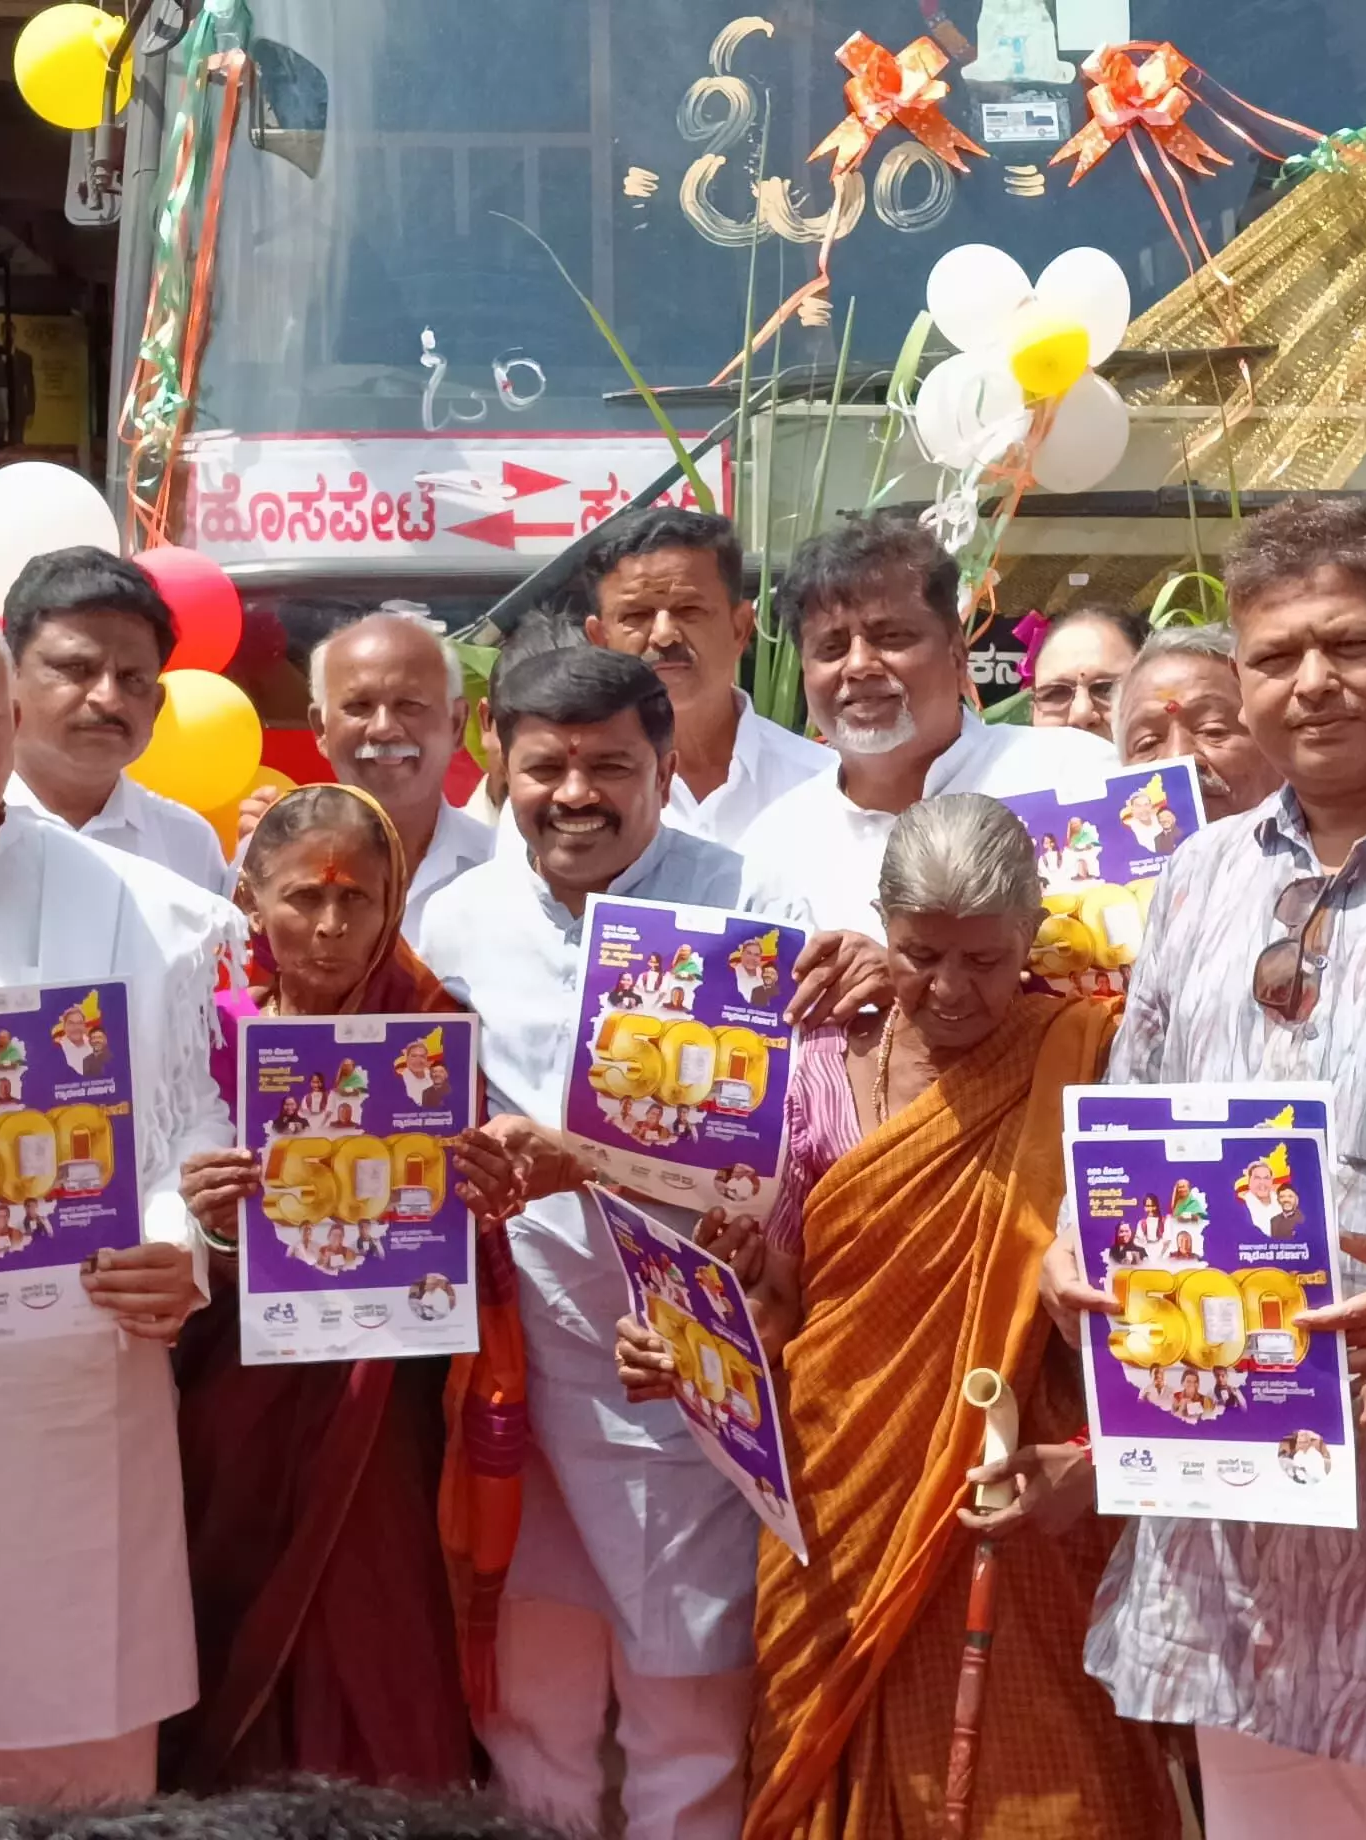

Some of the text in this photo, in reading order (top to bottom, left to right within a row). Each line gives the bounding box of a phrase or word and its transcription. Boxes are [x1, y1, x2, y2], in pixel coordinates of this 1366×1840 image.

[589, 1012, 769, 1109] 500
[262, 1133, 447, 1226] 500
[1108, 1268, 1309, 1369] 500
